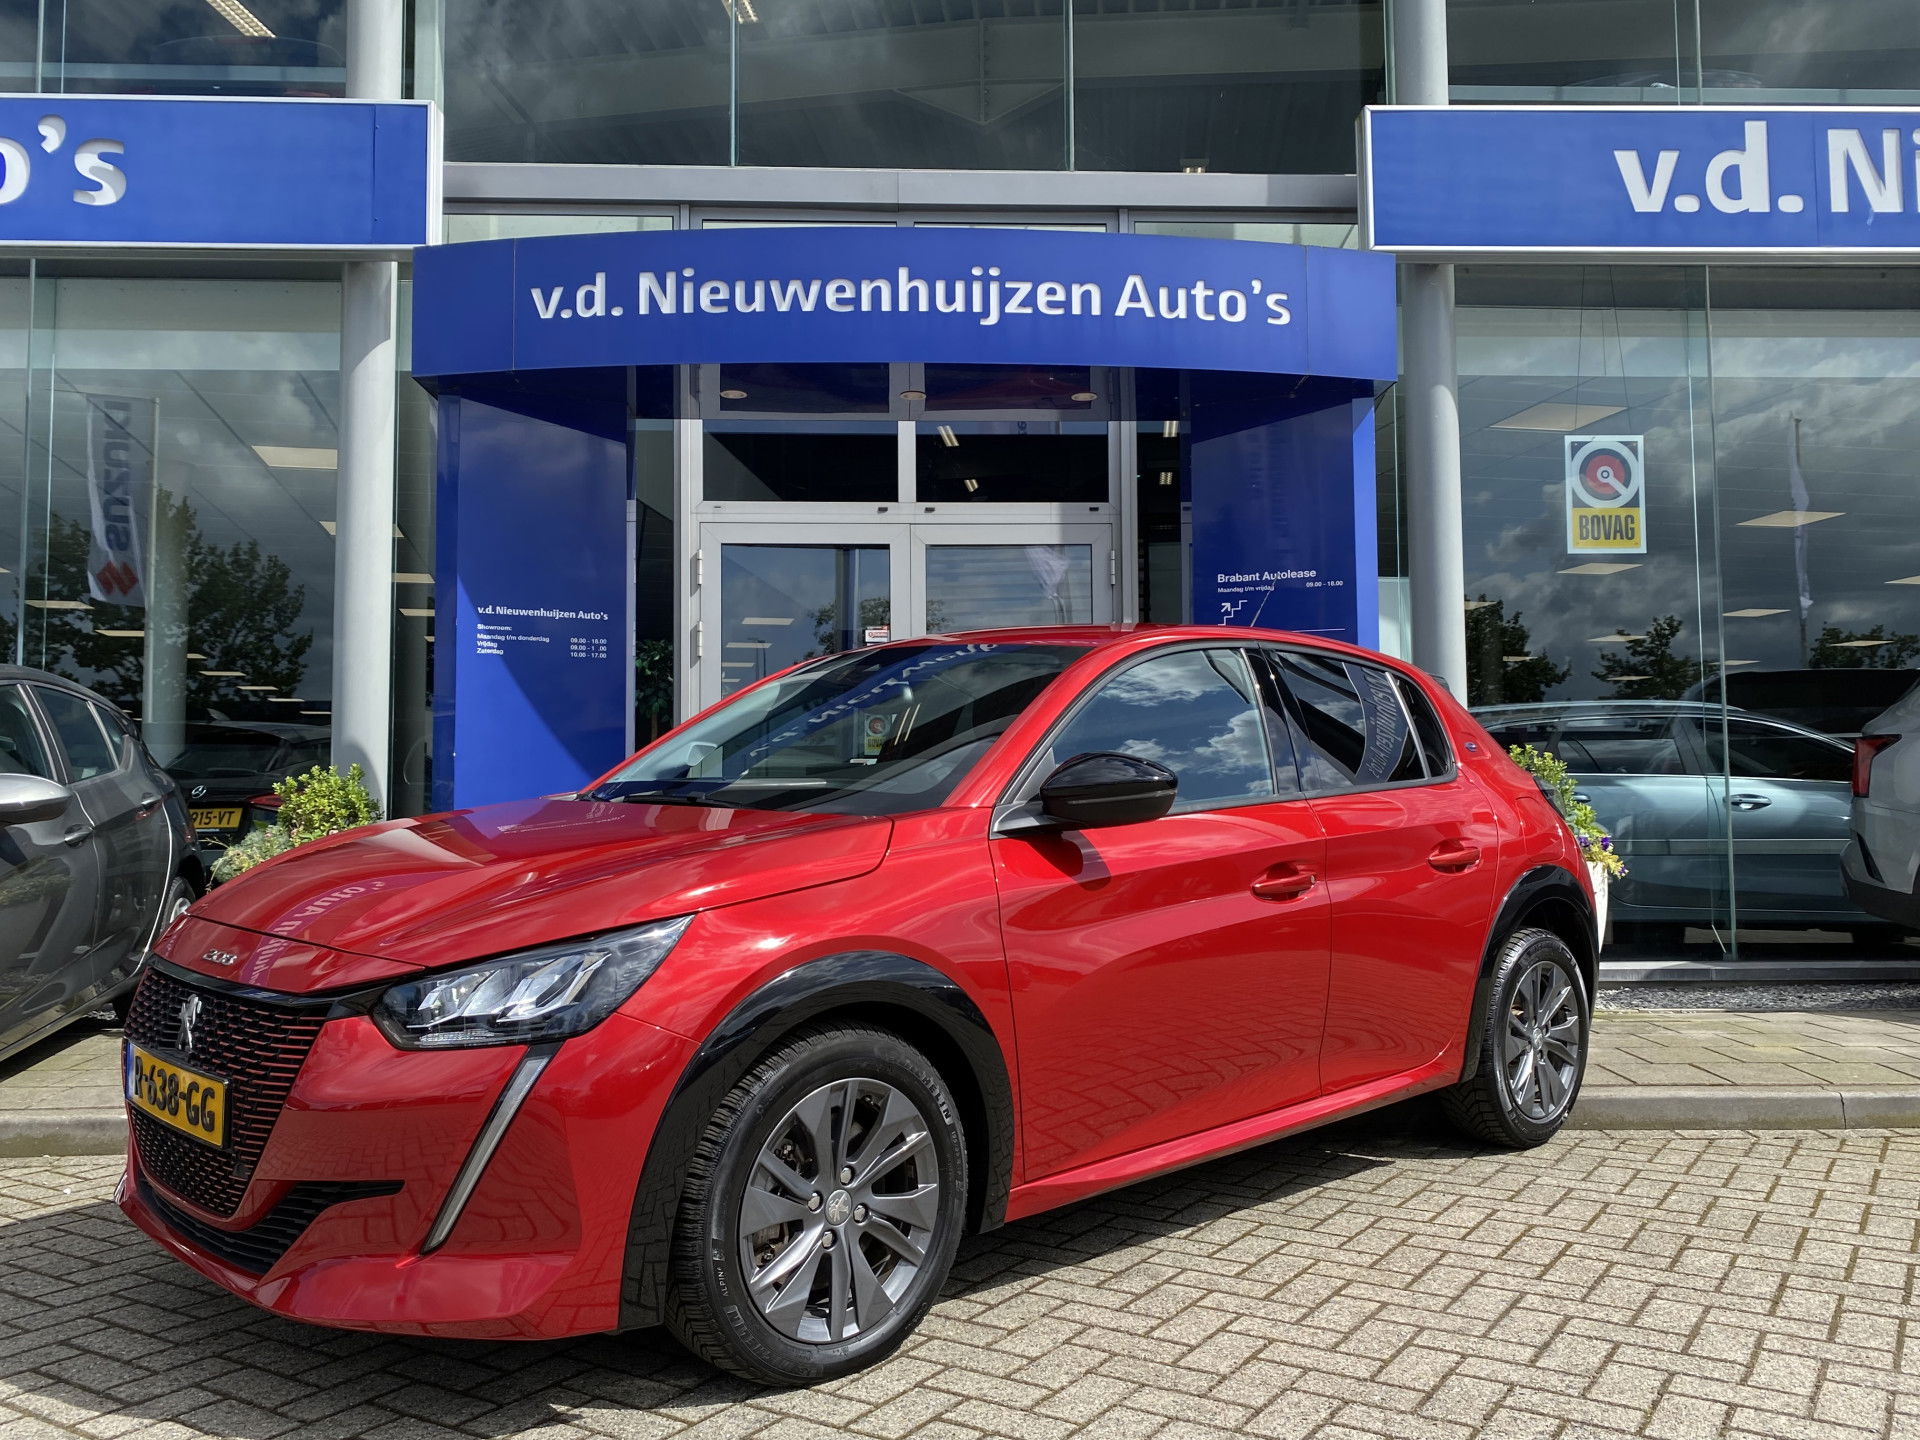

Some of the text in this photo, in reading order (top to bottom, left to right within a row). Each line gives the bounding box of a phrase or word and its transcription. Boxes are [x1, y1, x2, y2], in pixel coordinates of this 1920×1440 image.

[1613, 120, 1804, 213] v.d.
[530, 266, 1291, 325] v.d. Nieuwenhuijzen Auto's
[1578, 513, 1635, 541] BOVAG
[1217, 569, 1316, 583] Brabant Autolease
[477, 605, 608, 621] v.d. Nieuwenhuijzen Auto's
[476, 623, 512, 631] Showroom:
[476, 640, 498, 648] Vrijdag
[518, 635, 550, 643] donderdag
[202, 949, 238, 966] 208
[134, 1055, 216, 1133] R-638-GG
